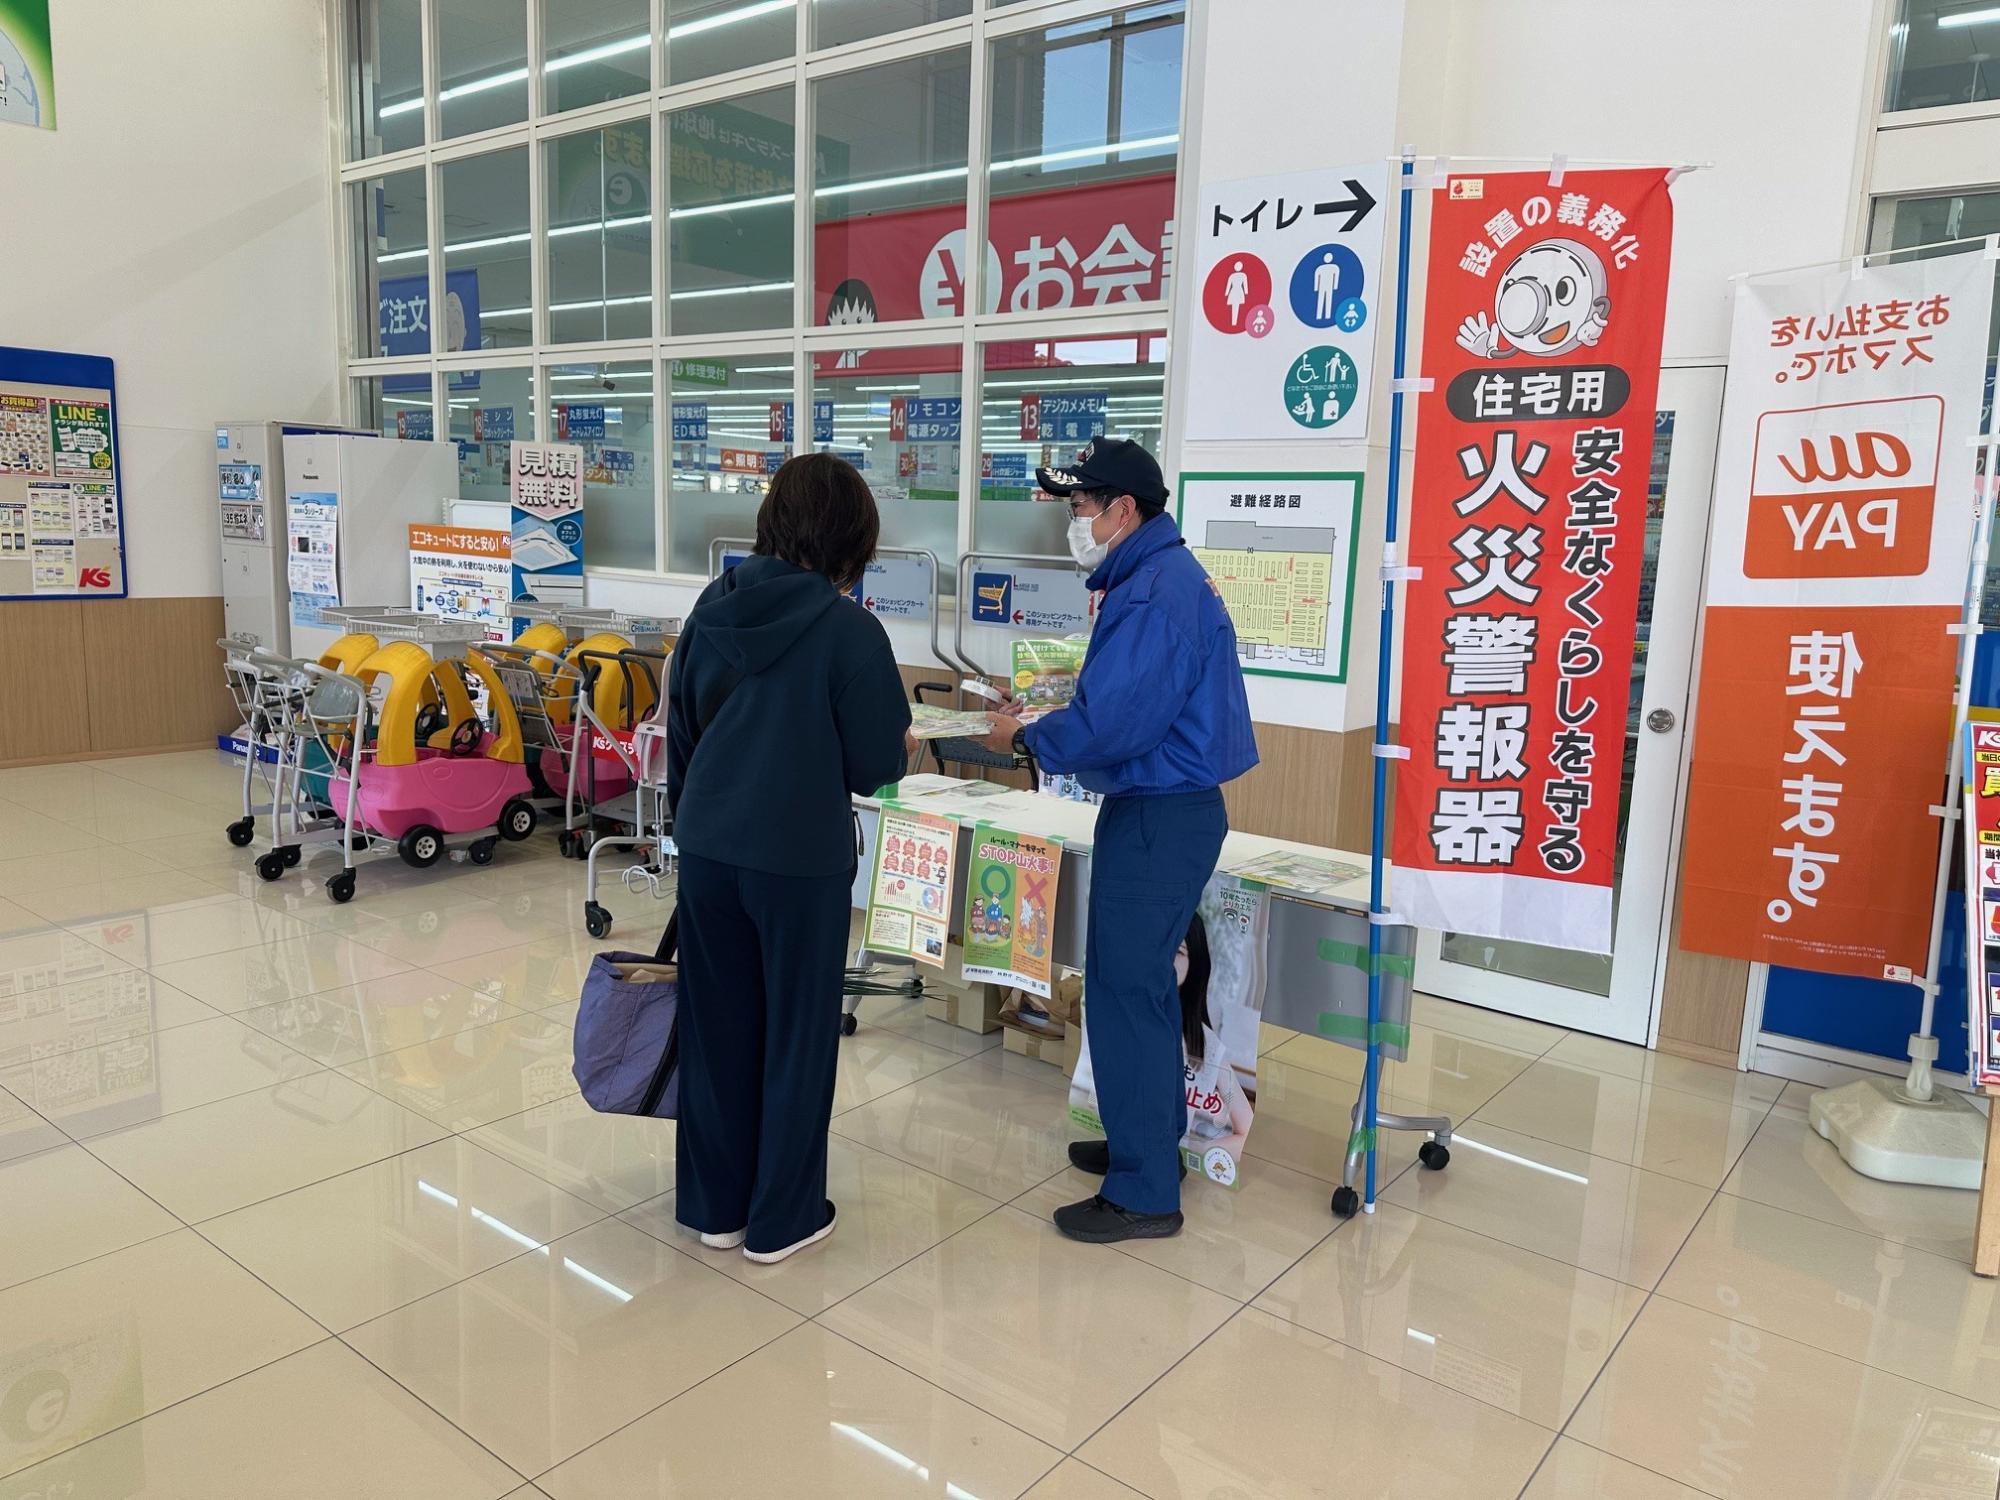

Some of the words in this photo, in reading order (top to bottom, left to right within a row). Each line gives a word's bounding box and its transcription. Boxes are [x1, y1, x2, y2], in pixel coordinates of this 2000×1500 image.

[1213, 198, 1303, 237] トイレ
[1459, 193, 1641, 278] 設置の義務化
[1473, 371, 1606, 418] 住宅用
[558, 413, 568, 432] 17
[770, 411, 782, 432] 15
[891, 408, 905, 432] 14
[908, 403, 961, 417] リモコン
[1022, 404, 1039, 430] 13
[519, 448, 577, 478] 見積
[519, 481, 578, 508] 無料
[1230, 494, 1301, 509] 避難経路図
[1430, 429, 1551, 867] 火災警報器
[1538, 427, 1623, 874] 安全なくらしを守る
[978, 843, 1057, 875] STOP山火事!
